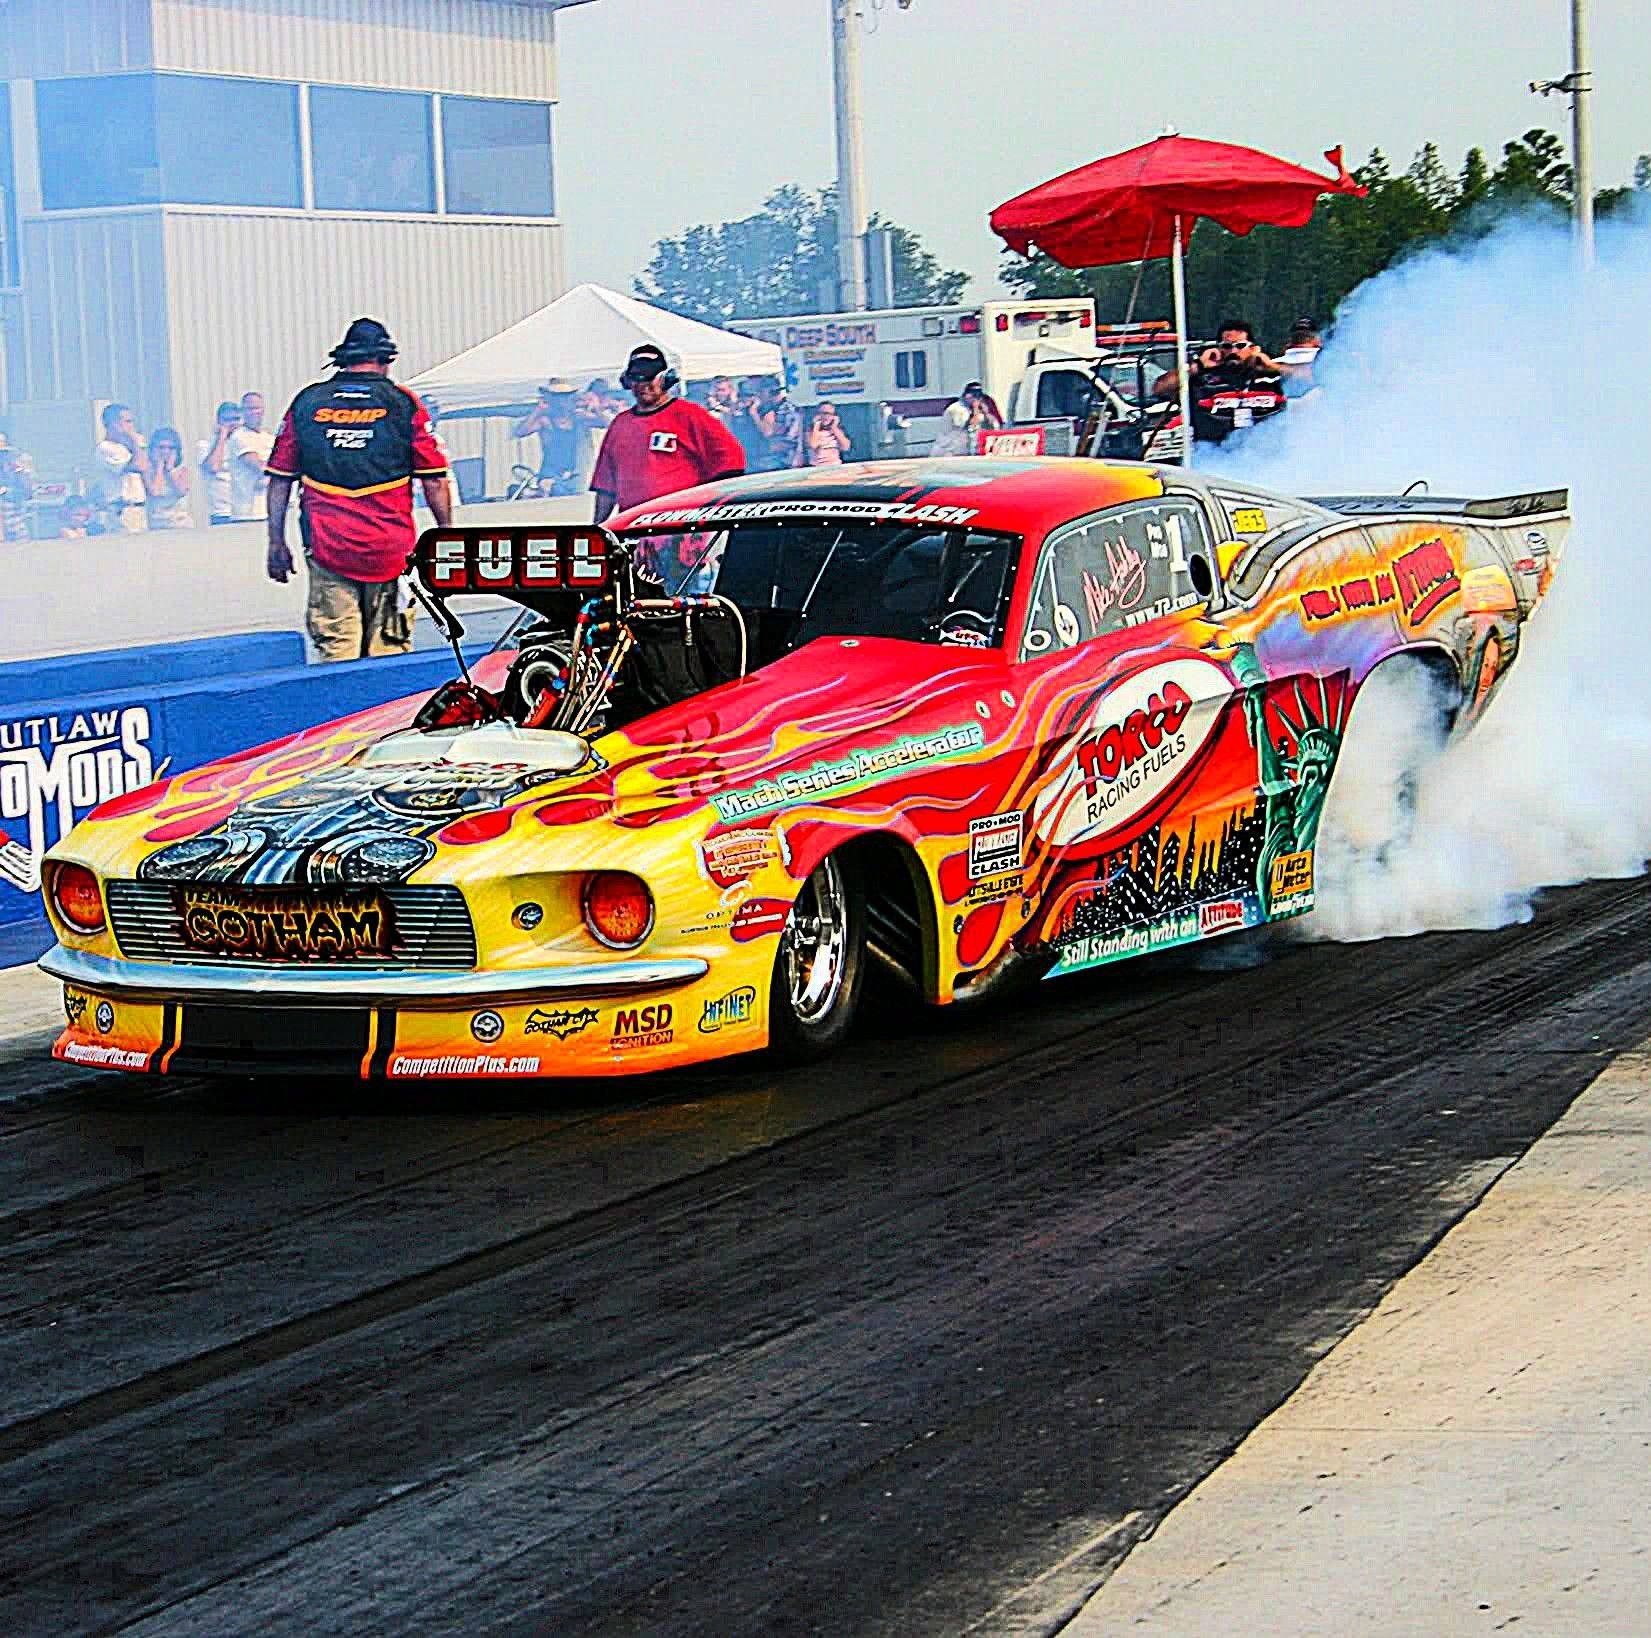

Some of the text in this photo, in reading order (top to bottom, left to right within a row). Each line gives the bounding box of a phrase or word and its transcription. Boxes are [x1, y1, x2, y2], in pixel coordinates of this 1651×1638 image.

[313, 408, 387, 424] SGMP
[435, 538, 602, 580] FUEL
[1077, 680, 1193, 801] TORCO
[714, 726, 984, 820] Mach Series Accelerator
[1087, 733, 1186, 824] RACING FUELS
[971, 855, 1020, 876] CLASH
[185, 905, 383, 952] GOTHAM
[1063, 937, 1090, 966] Still
[1090, 927, 1149, 959] Standing
[1149, 917, 1178, 944] with
[1179, 920, 1198, 937] an
[613, 1003, 673, 1035] MSD
[392, 1055, 541, 1077] CompetitionPlus.com
